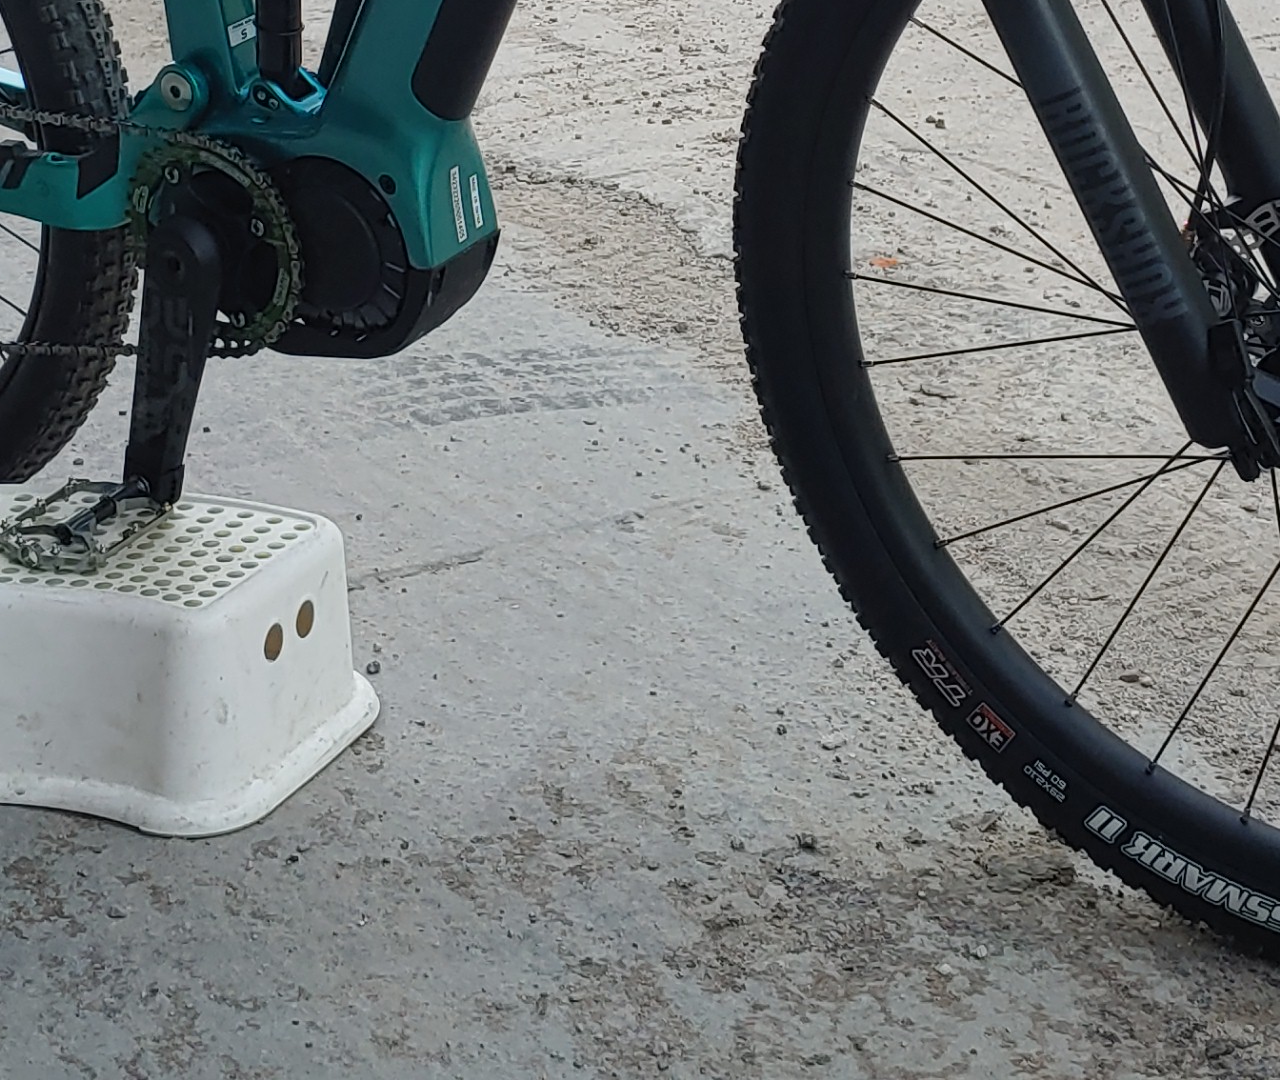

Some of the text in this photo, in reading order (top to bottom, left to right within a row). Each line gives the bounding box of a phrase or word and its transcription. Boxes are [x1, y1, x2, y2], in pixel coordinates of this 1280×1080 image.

[1041, 87, 1192, 321] ROCKSHOX
[911, 647, 966, 707] TR
[970, 708, 1008, 751] EXO
[1033, 759, 1052, 778] PSI
